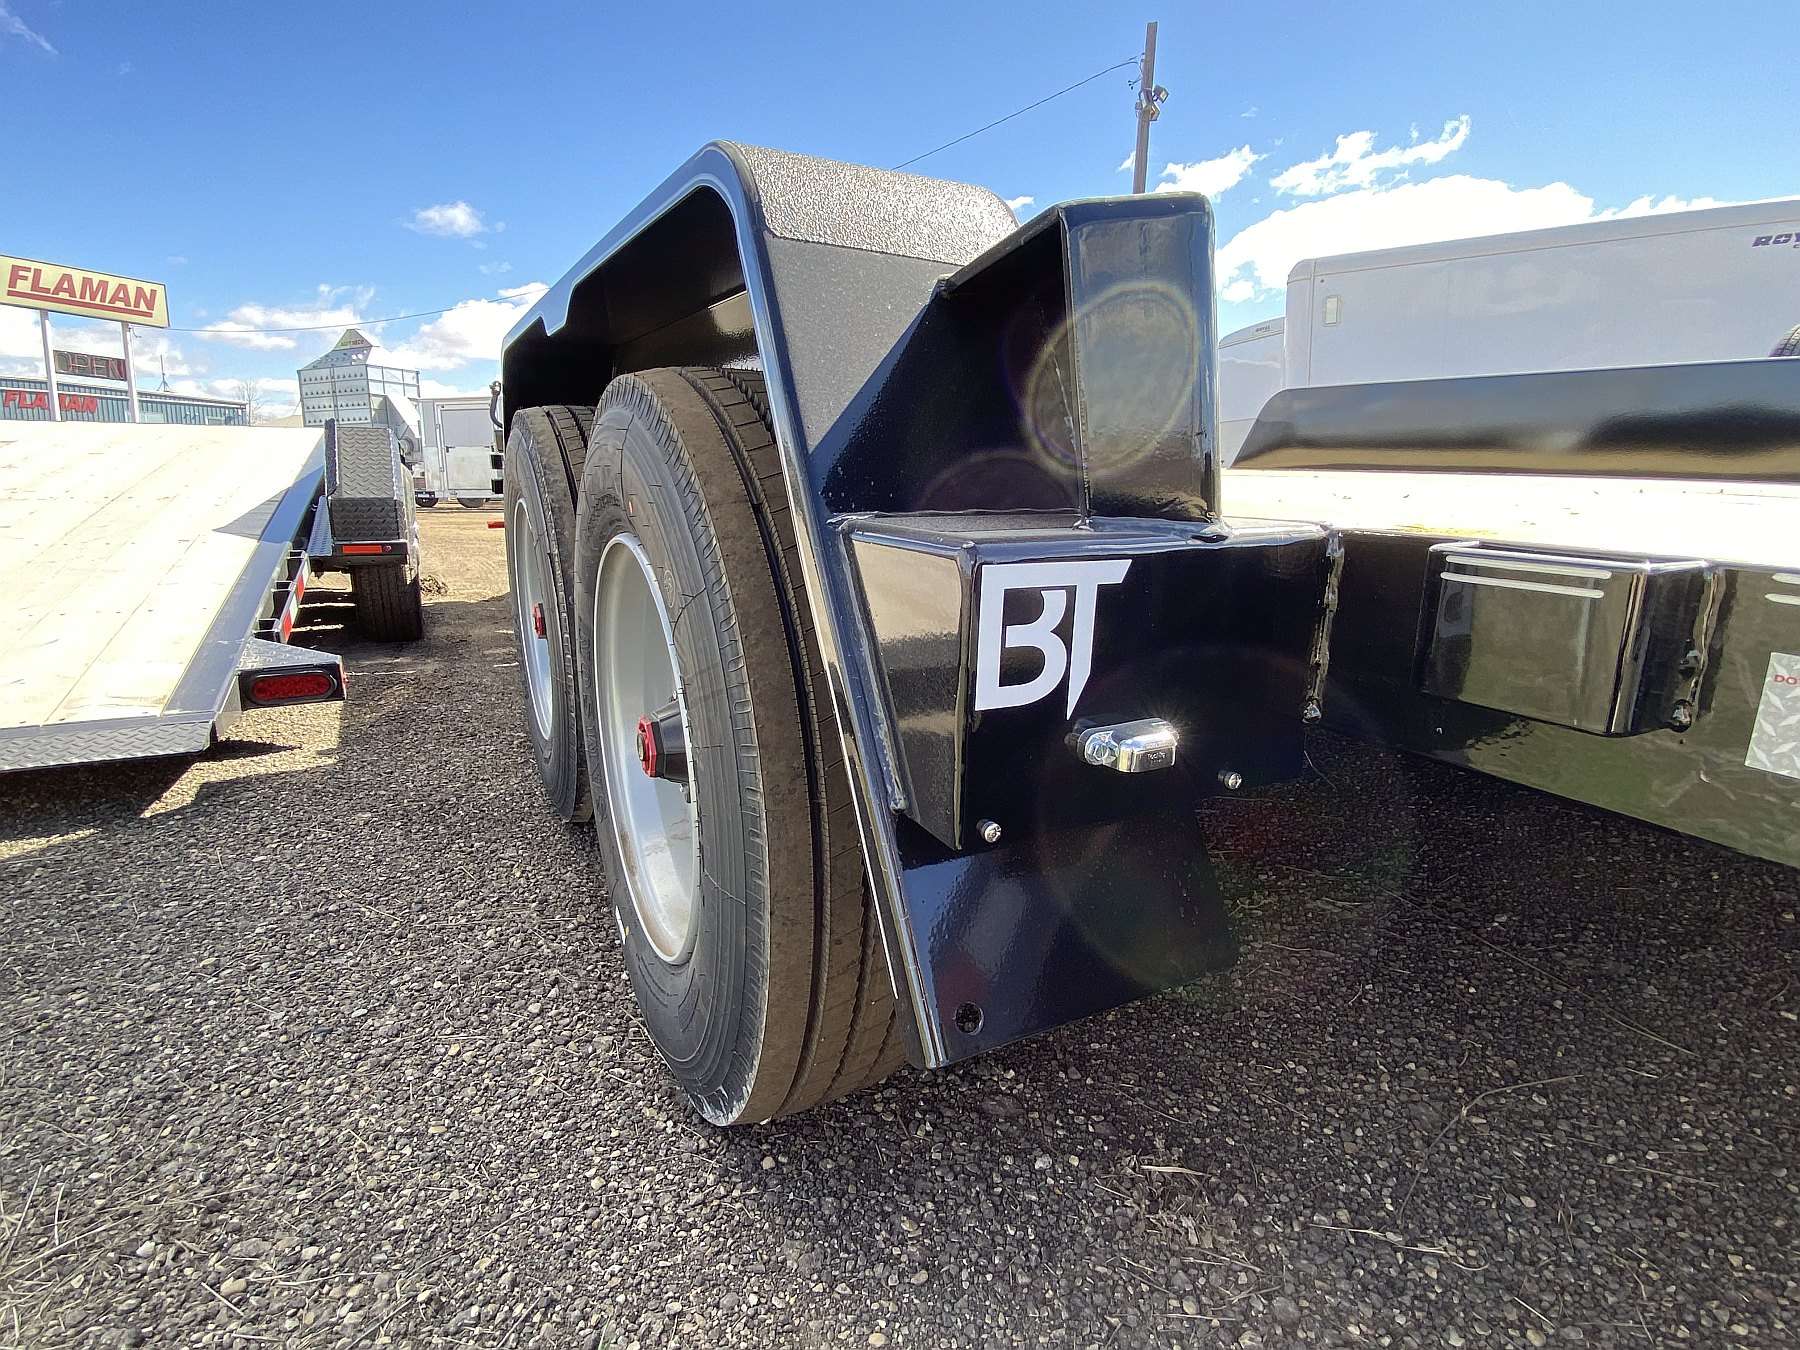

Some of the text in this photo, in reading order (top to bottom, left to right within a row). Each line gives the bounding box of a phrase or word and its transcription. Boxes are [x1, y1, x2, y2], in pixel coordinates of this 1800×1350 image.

[8, 264, 157, 311] FLAMAN
[56, 351, 127, 380] OPEN
[975, 559, 1132, 720] BT
